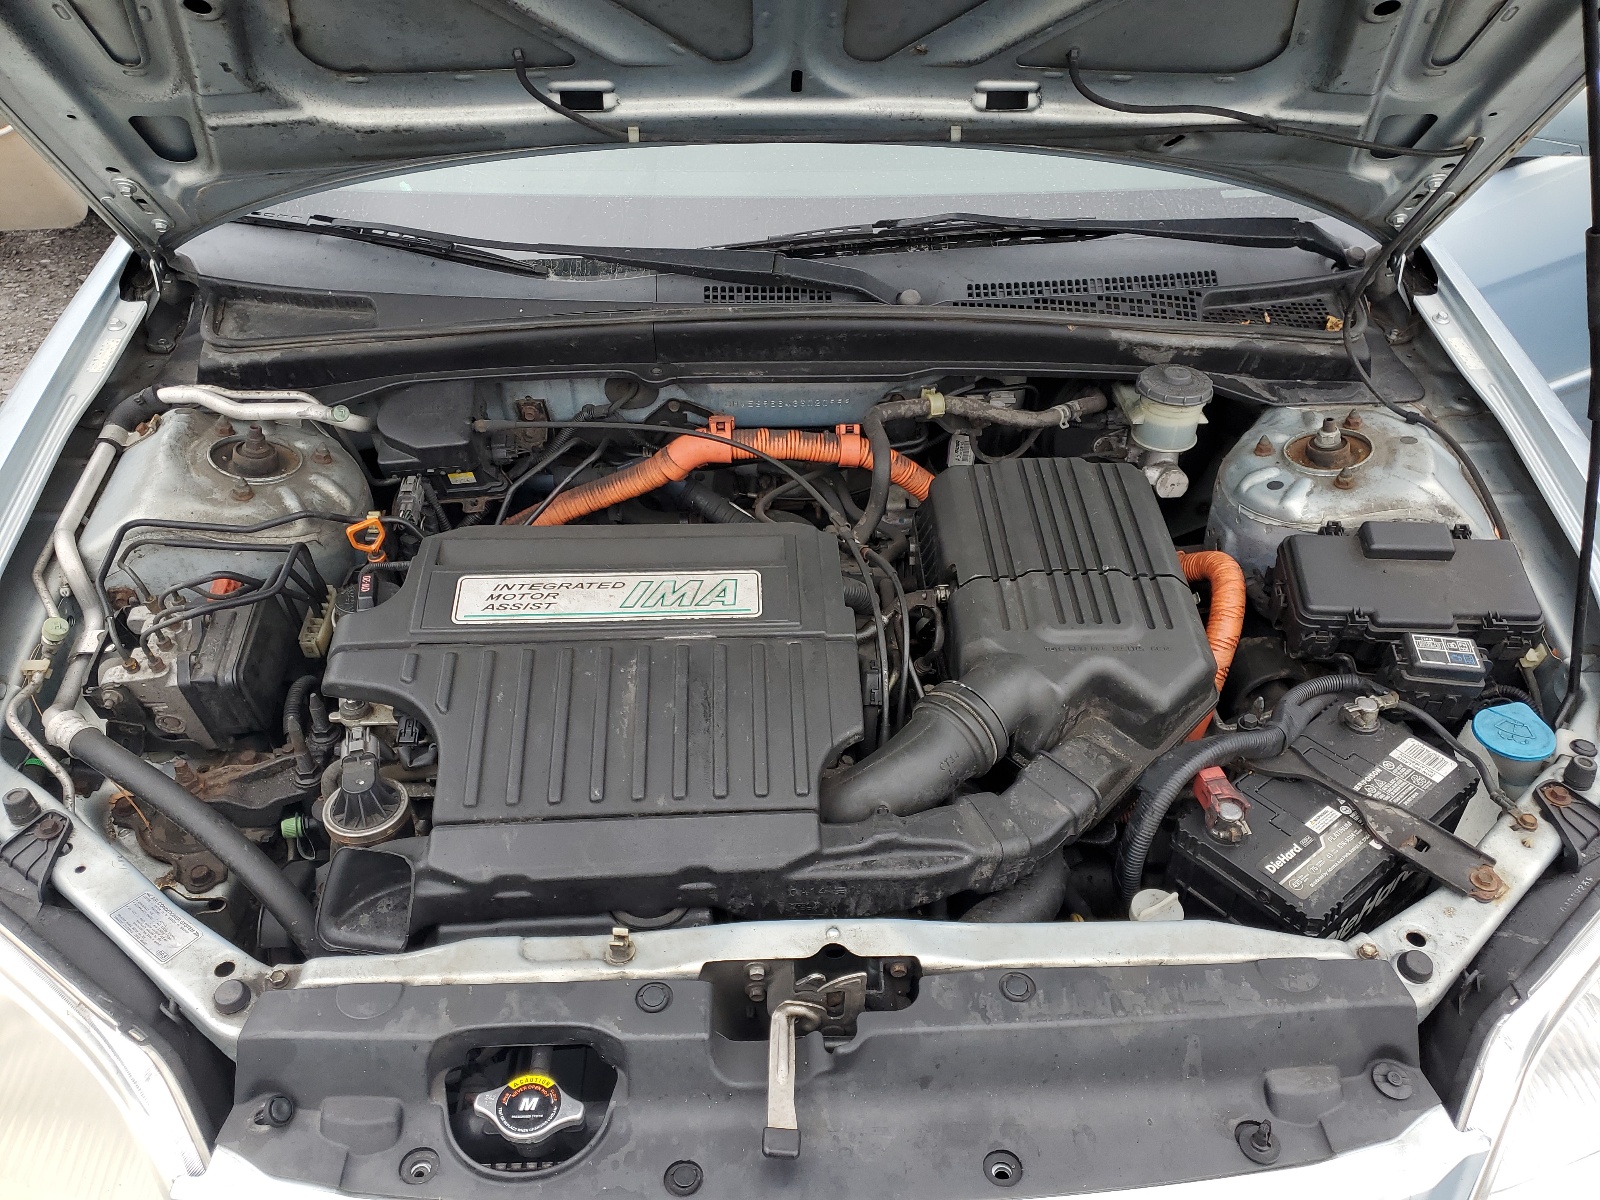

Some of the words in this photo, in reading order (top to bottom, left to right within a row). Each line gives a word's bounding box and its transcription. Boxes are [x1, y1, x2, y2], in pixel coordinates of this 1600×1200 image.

[493, 581, 626, 591] INTEGRATED
[486, 592, 560, 602] MOTOR
[619, 578, 738, 608] IMA
[480, 602, 558, 612] ASSIST
[1264, 842, 1303, 875] DieHard
[519, 1077, 551, 1087] CAUTION
